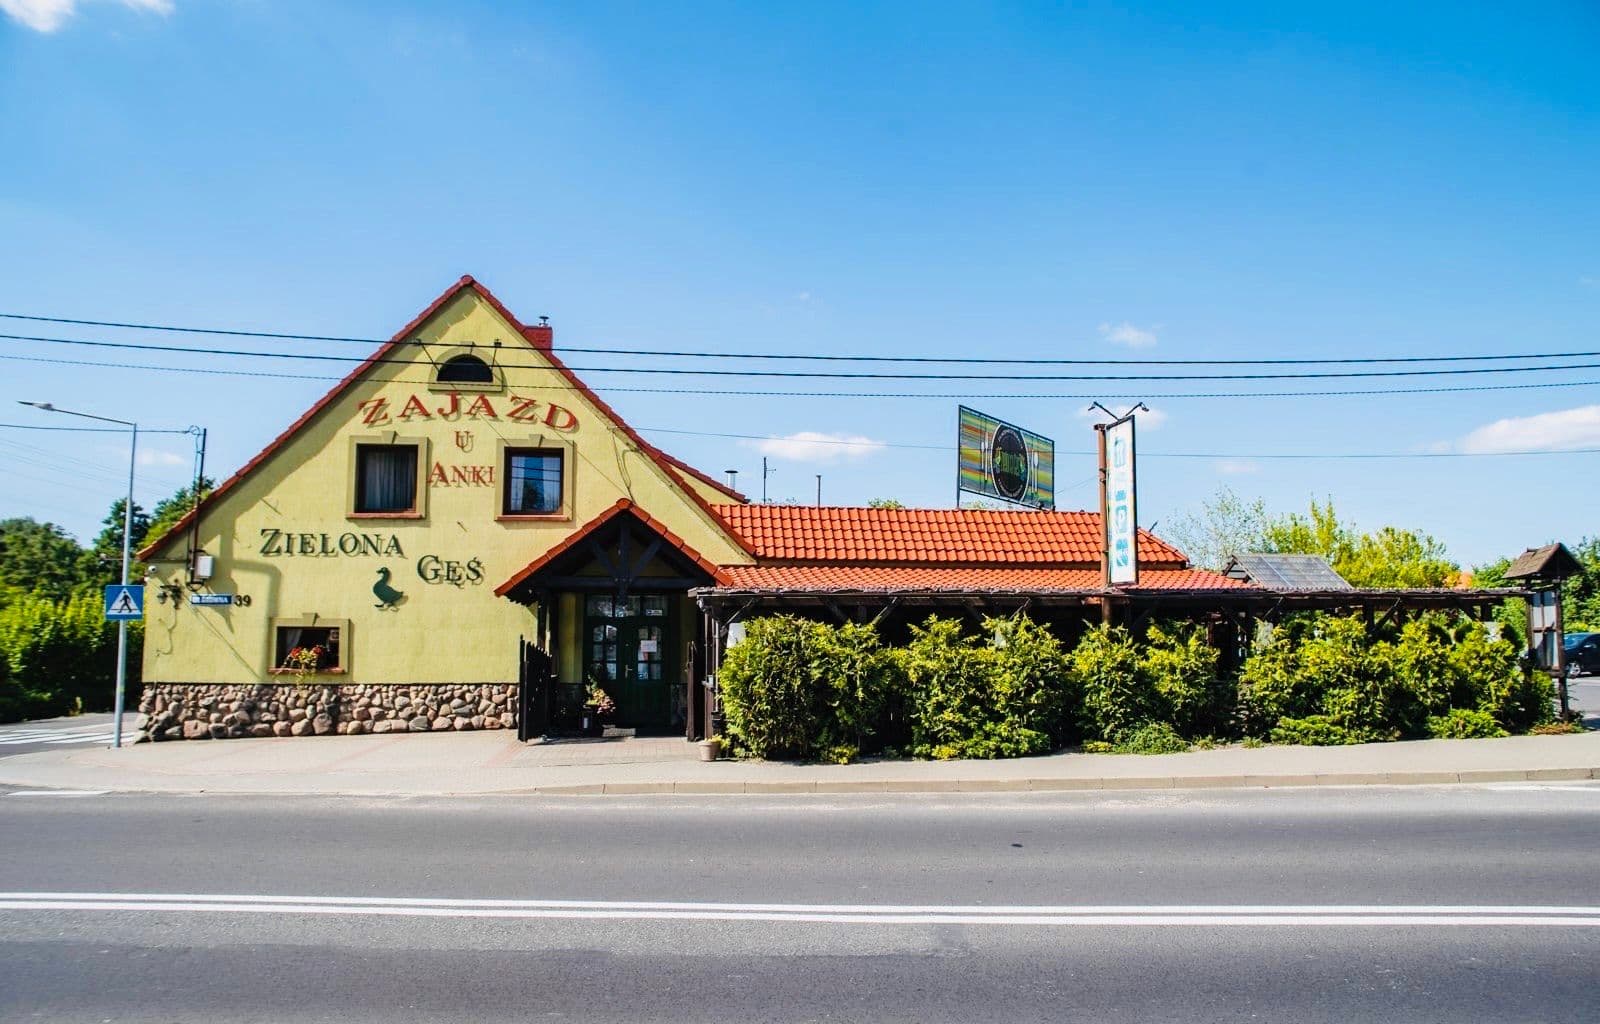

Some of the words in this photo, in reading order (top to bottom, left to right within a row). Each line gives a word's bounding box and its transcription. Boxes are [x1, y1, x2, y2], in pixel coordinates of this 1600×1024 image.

[359, 391, 577, 429] ZAJAZD
[455, 431, 471, 450] U
[428, 461, 495, 485] ANKI
[260, 528, 404, 556] ZIELONA
[234, 595, 252, 607] 39
